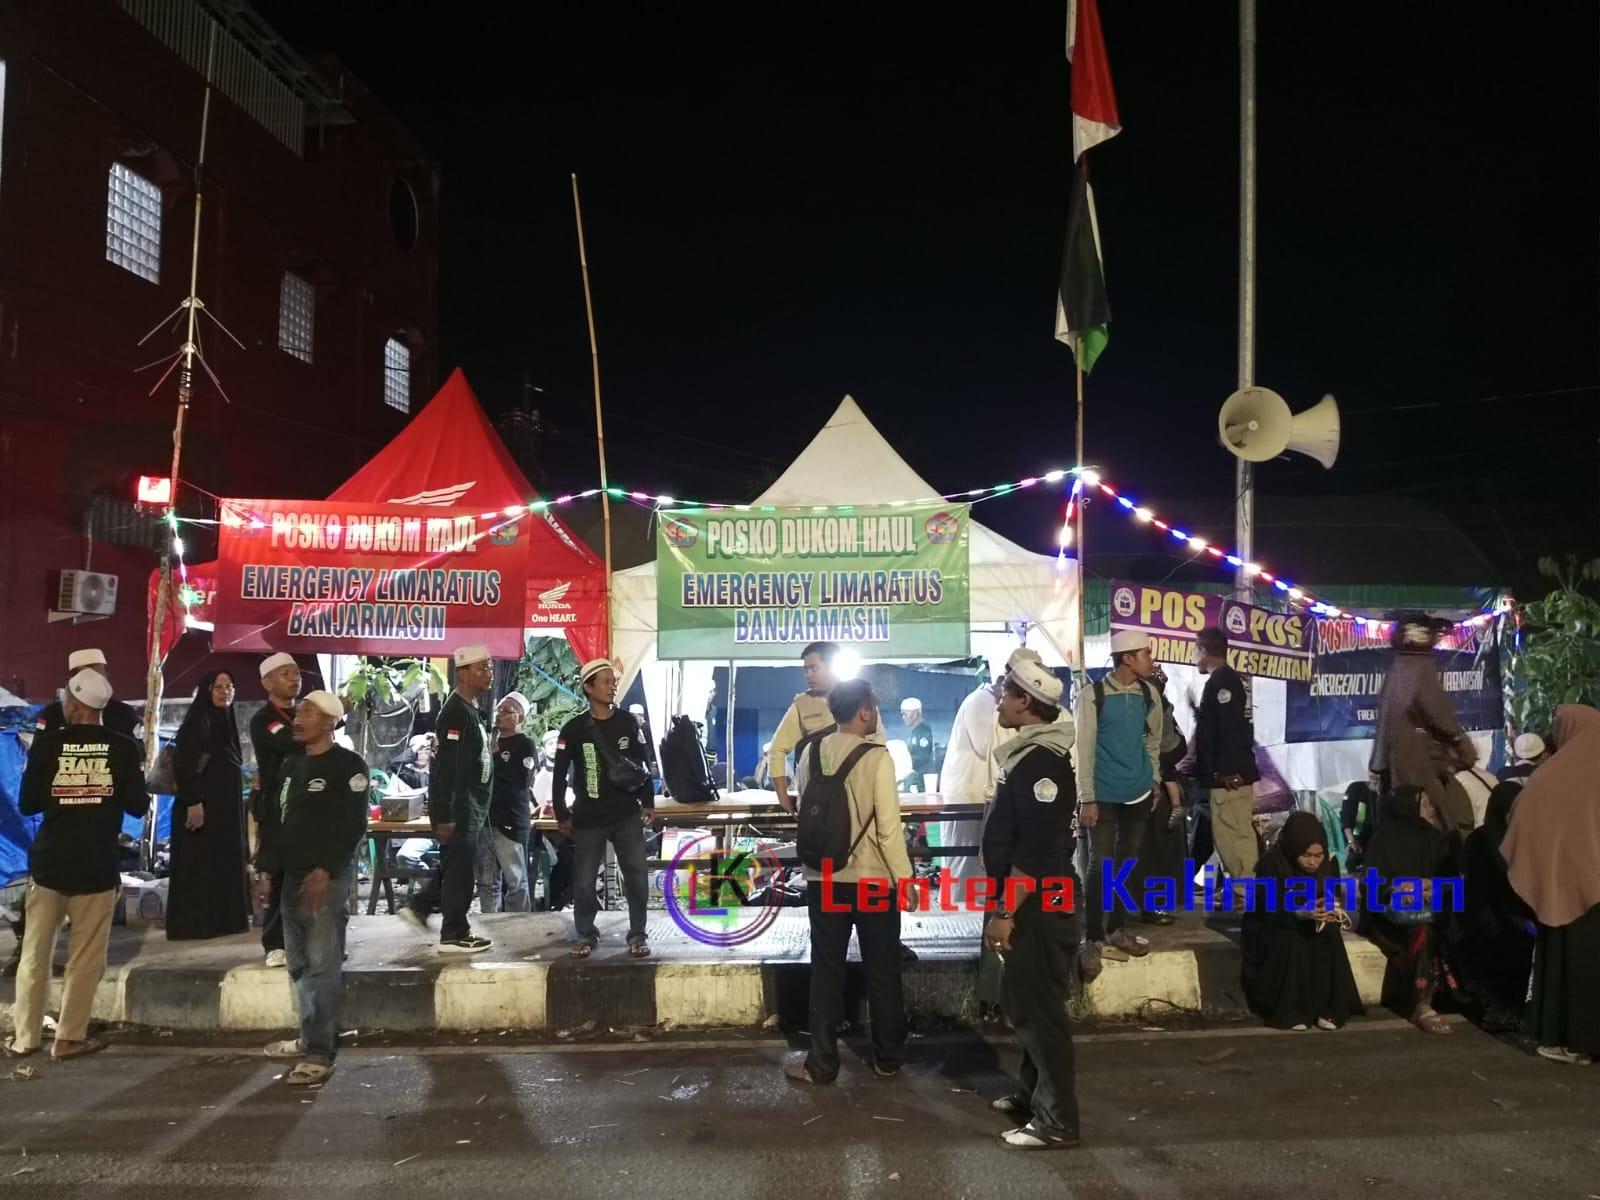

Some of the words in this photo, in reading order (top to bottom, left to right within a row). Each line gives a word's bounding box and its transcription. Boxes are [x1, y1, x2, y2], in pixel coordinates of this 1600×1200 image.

[271, 512, 340, 549] POSKO
[344, 514, 422, 552] DUKOM
[425, 515, 477, 552] HAUL
[707, 518, 777, 557] POSKO
[780, 517, 858, 556] DUKOM
[862, 516, 917, 555] HAUL
[241, 566, 373, 601] EMERGENCY
[376, 569, 501, 606] LIMARATUS
[682, 571, 813, 607] EMERGENCY
[820, 569, 943, 605] LIMARATUS
[287, 603, 446, 641] BANJARMASIN
[532, 614, 548, 622] One
[549, 613, 577, 623] HEART.
[735, 606, 890, 642] BANJARMASIN
[1140, 588, 1206, 631] POS
[1250, 609, 1303, 648] POS
[1317, 618, 1357, 654] POSKO
[1149, 636, 1198, 665] ORMA
[1227, 648, 1312, 681] KESEHATAN
[1310, 673, 1368, 696] EMERGENCY
[58, 757, 110, 774] HAUL
[63, 744, 109, 752] RELAWAN
